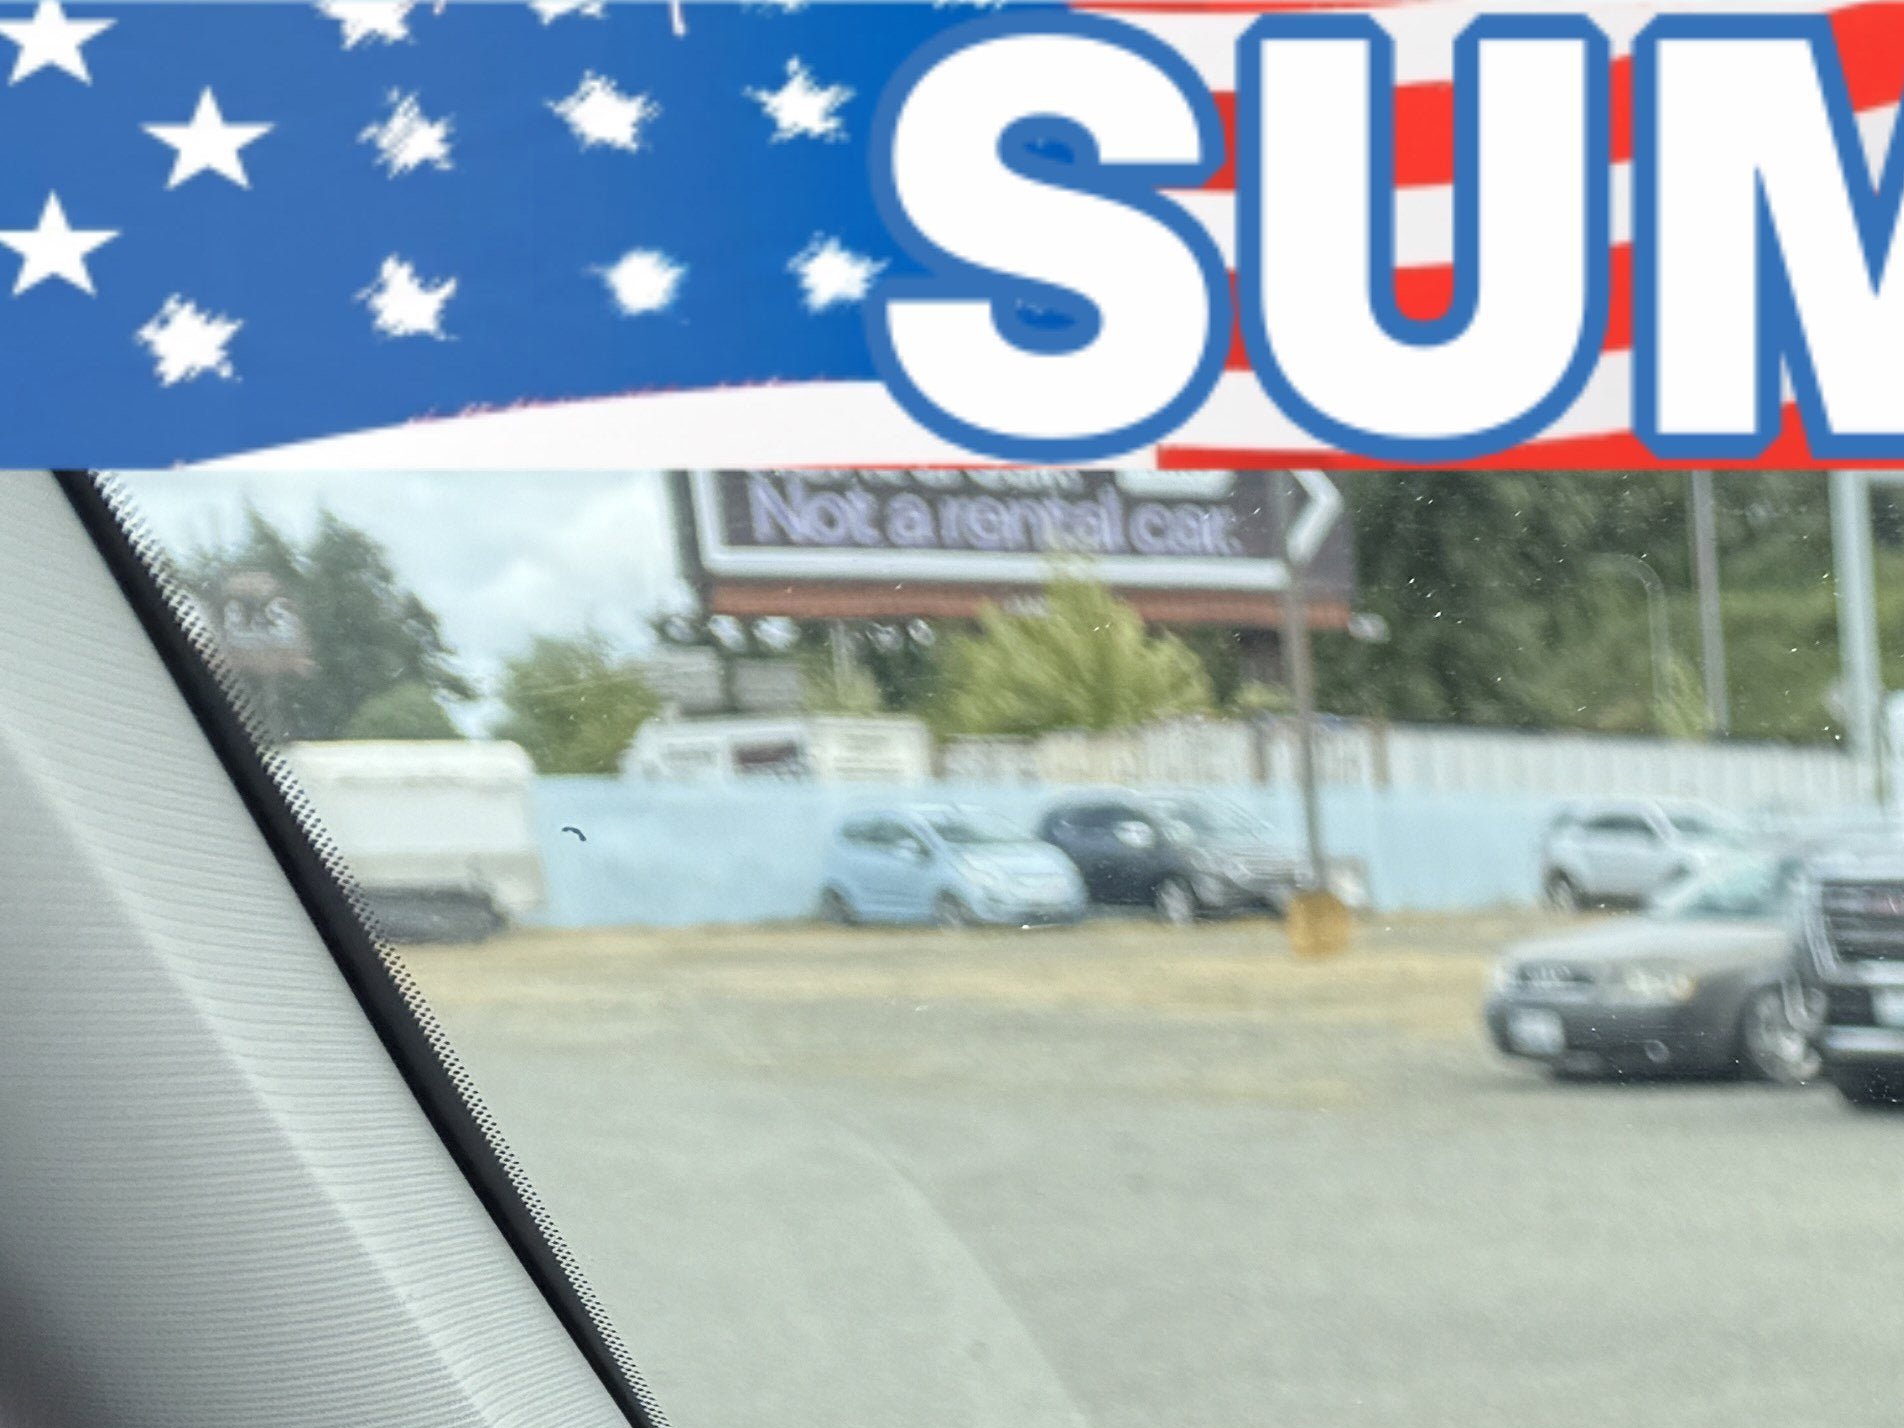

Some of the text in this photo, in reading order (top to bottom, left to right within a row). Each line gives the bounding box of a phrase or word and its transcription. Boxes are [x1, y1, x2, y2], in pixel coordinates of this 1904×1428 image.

[747, 478, 1242, 557] Not a rental car.
